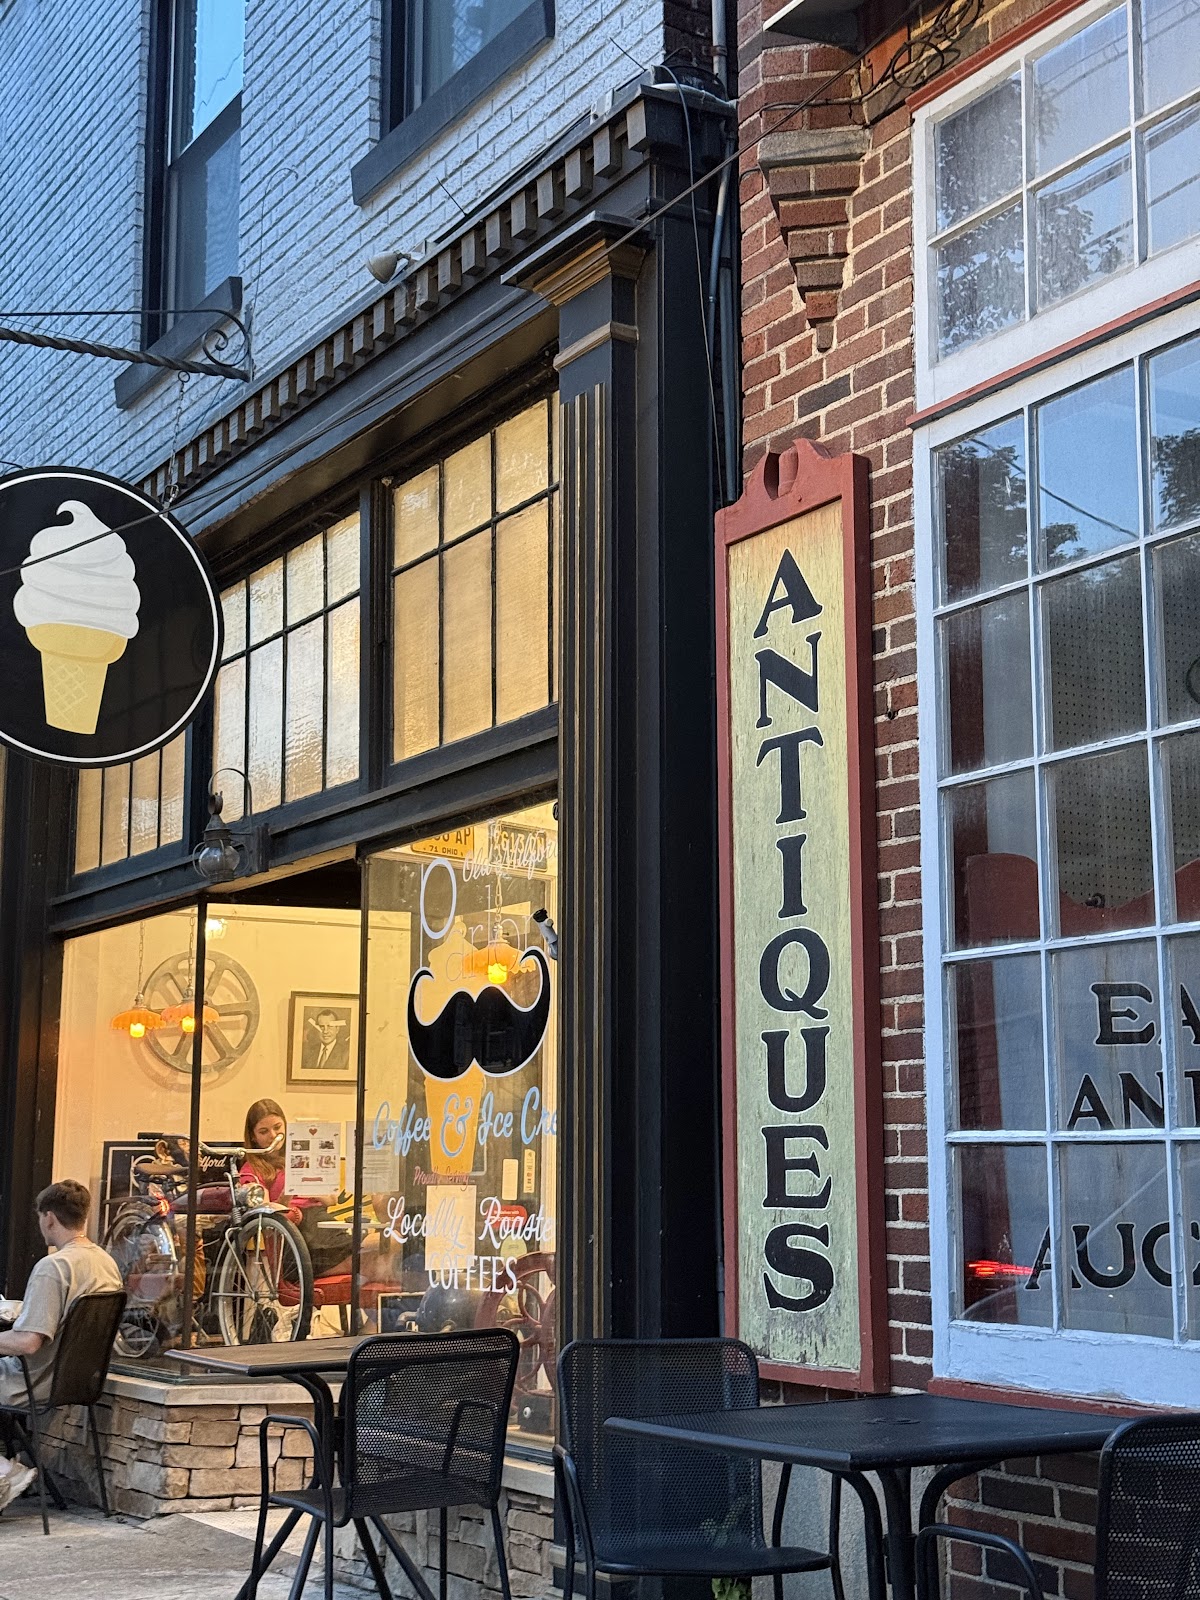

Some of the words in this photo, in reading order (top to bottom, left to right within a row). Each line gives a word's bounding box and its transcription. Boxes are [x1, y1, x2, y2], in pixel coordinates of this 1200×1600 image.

[428, 844, 439, 853] 71
[441, 846, 458, 856] OHIO
[753, 548, 835, 1312] ANTIQUES
[372, 1100, 432, 1157] Coffee
[439, 1092, 474, 1158] &
[477, 1090, 514, 1147] Ice
[412, 1165, 441, 1190] Proudly
[383, 1196, 467, 1249] Locally
[427, 1251, 518, 1295] COFFEES
